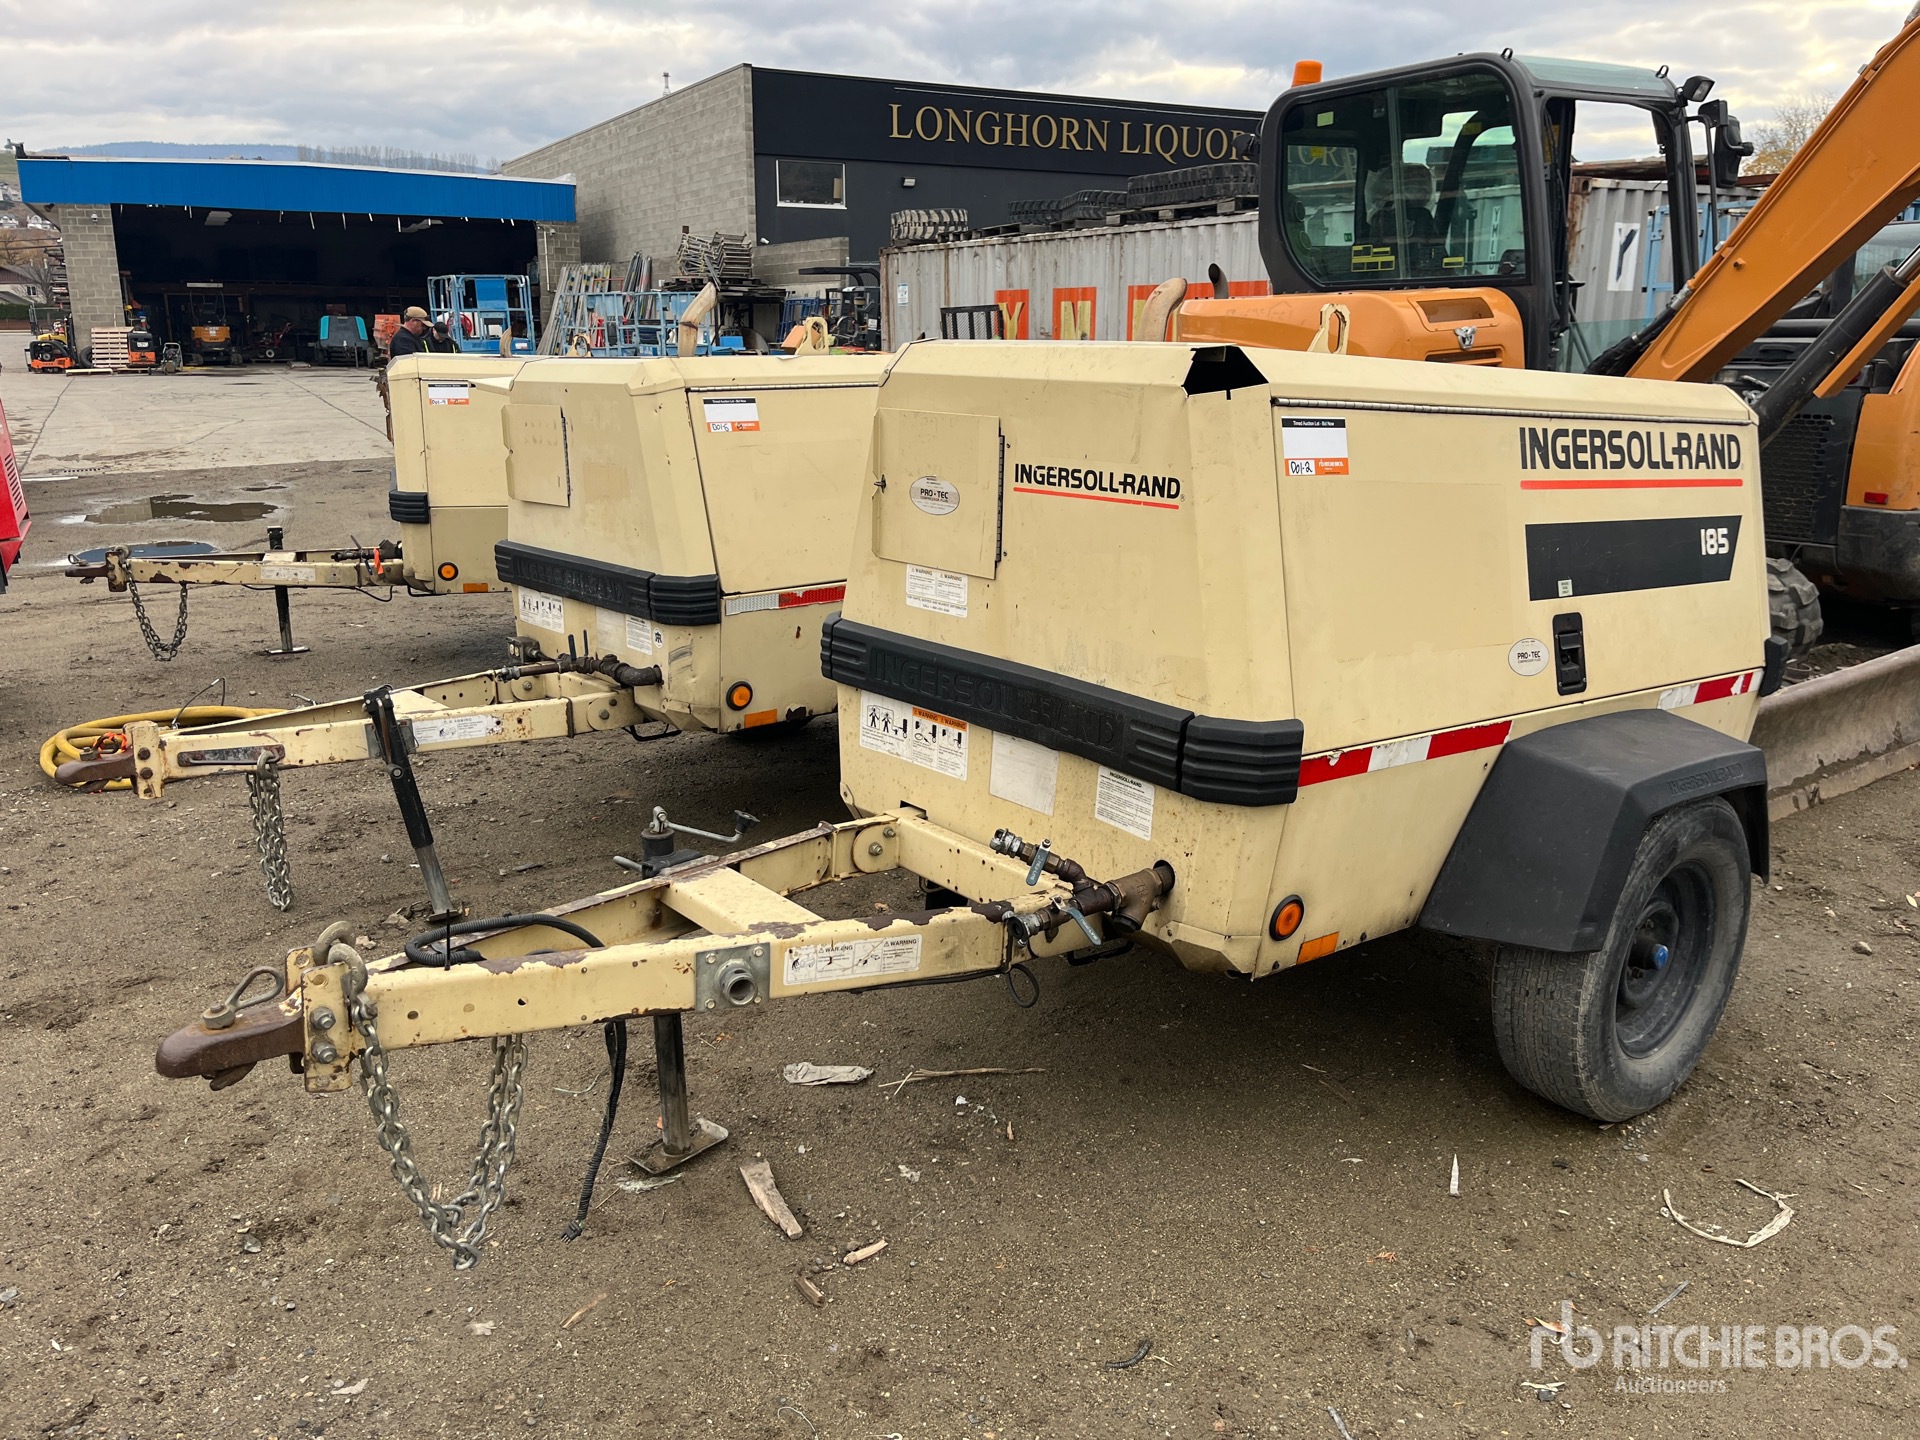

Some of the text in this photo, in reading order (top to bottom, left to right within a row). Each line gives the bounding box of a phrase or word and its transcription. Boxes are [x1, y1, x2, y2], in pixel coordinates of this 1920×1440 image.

[889, 103, 1111, 152] LONGHORN
[1519, 427, 1741, 470] INGERSOLL-RAND
[1015, 463, 1181, 499] INGERSOLL-RAND
[1700, 527, 1730, 556] 185
[918, 711, 938, 722] WARNING
[944, 718, 966, 731] WARNING
[890, 938, 917, 946] WARNING
